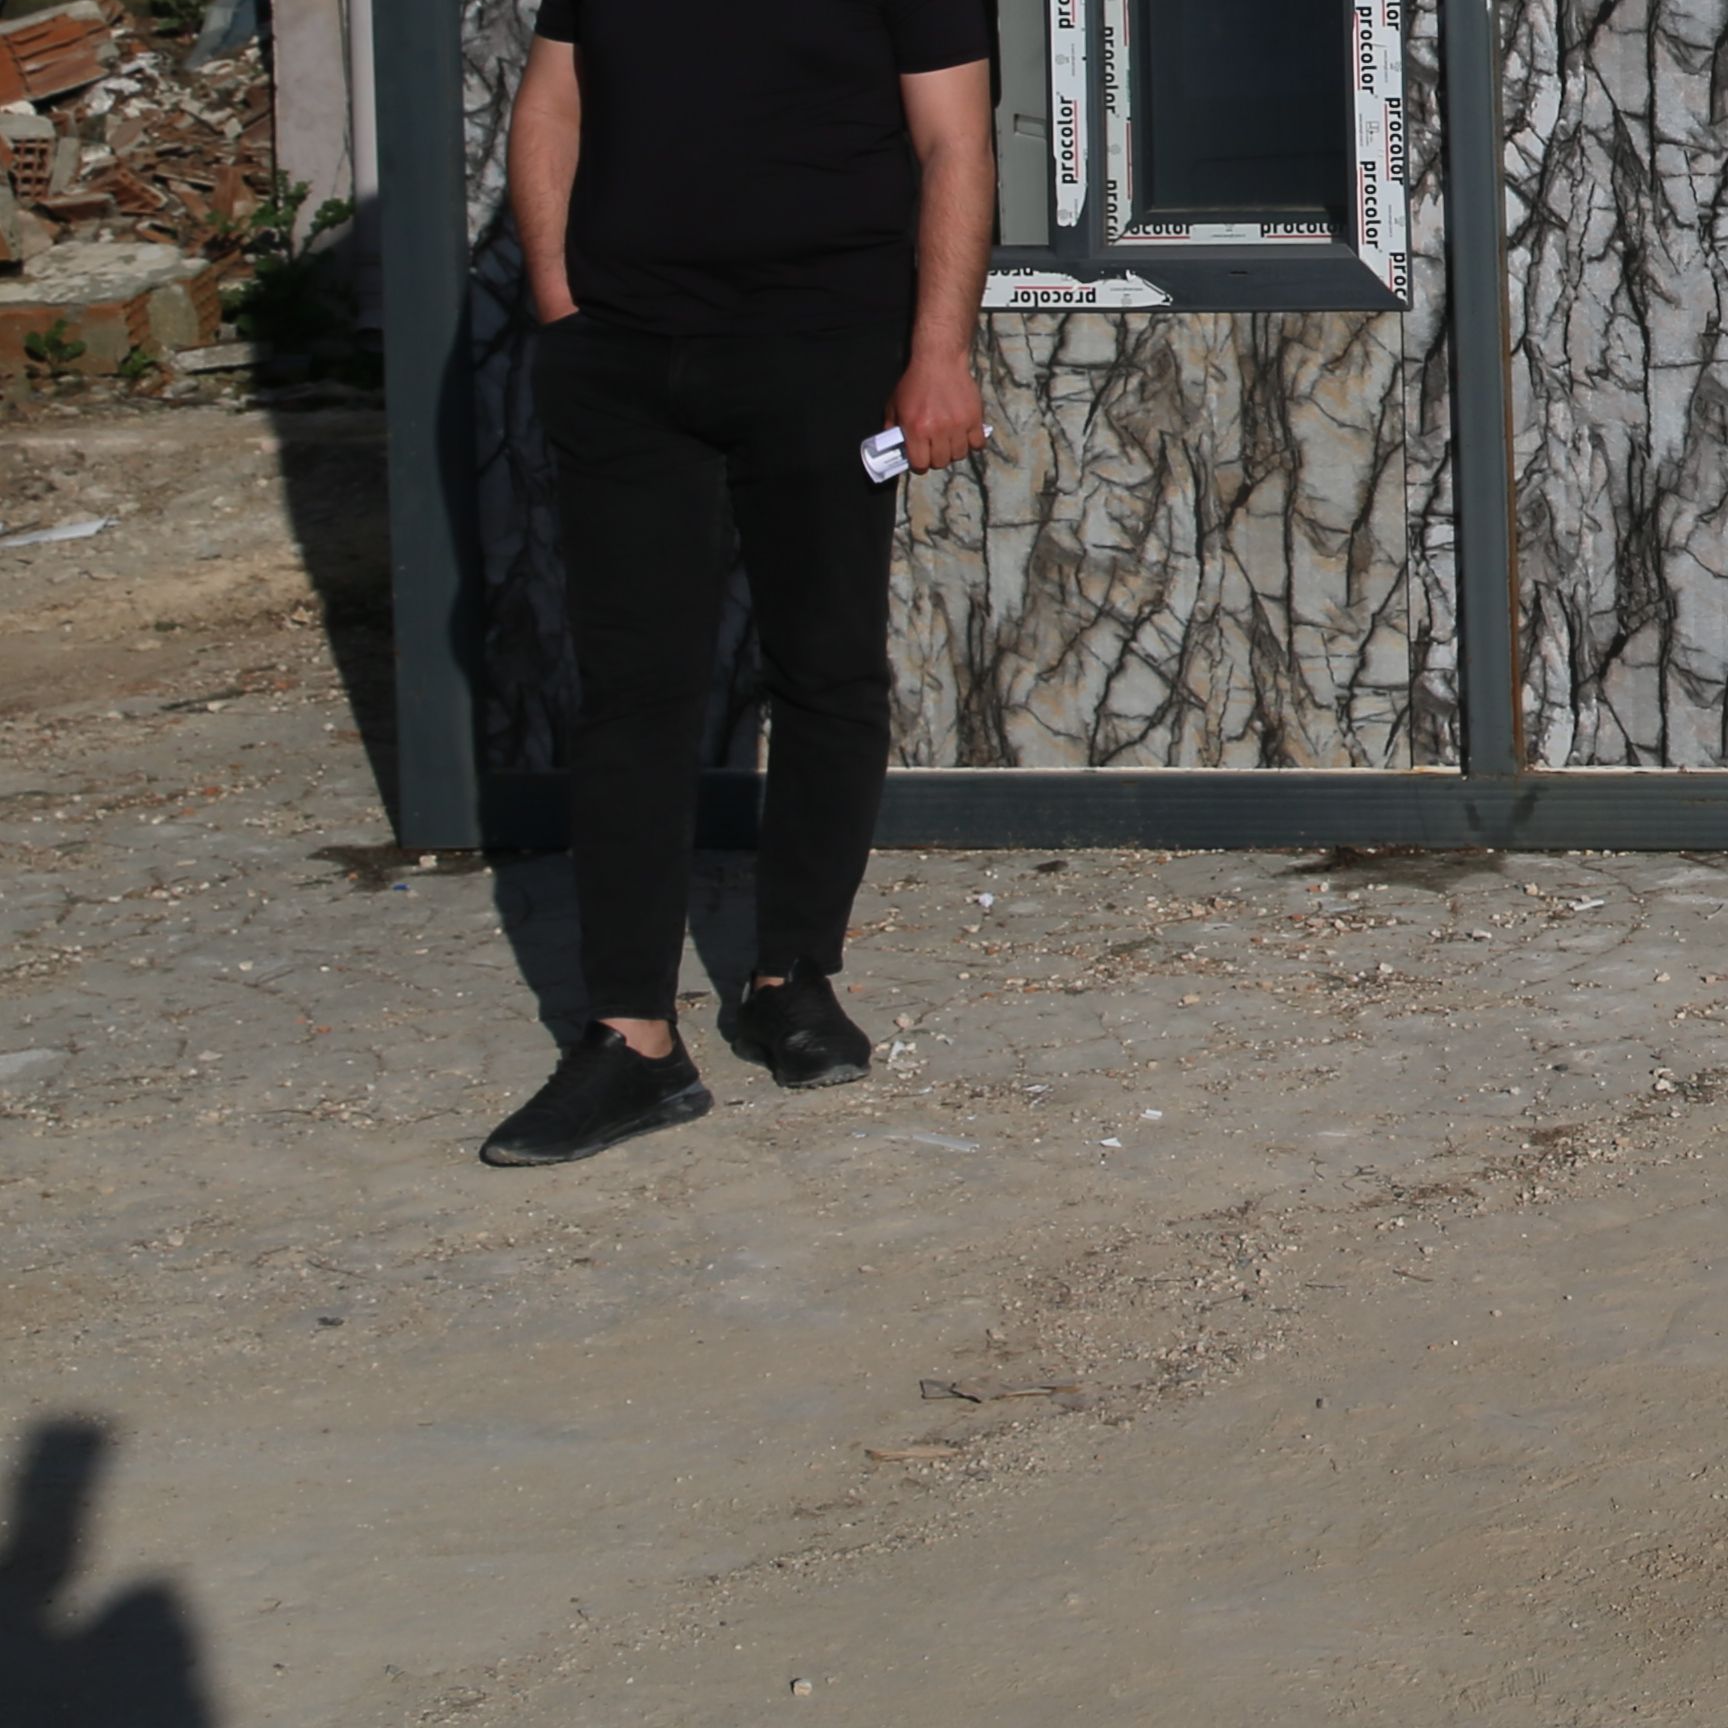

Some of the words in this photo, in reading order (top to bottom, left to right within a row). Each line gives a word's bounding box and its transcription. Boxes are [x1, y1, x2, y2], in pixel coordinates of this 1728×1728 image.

[1357, 6, 1374, 95] procolor
[1057, 95, 1078, 184] procolor
[1385, 97, 1403, 185] procolor
[1360, 161, 1379, 249] procolor
